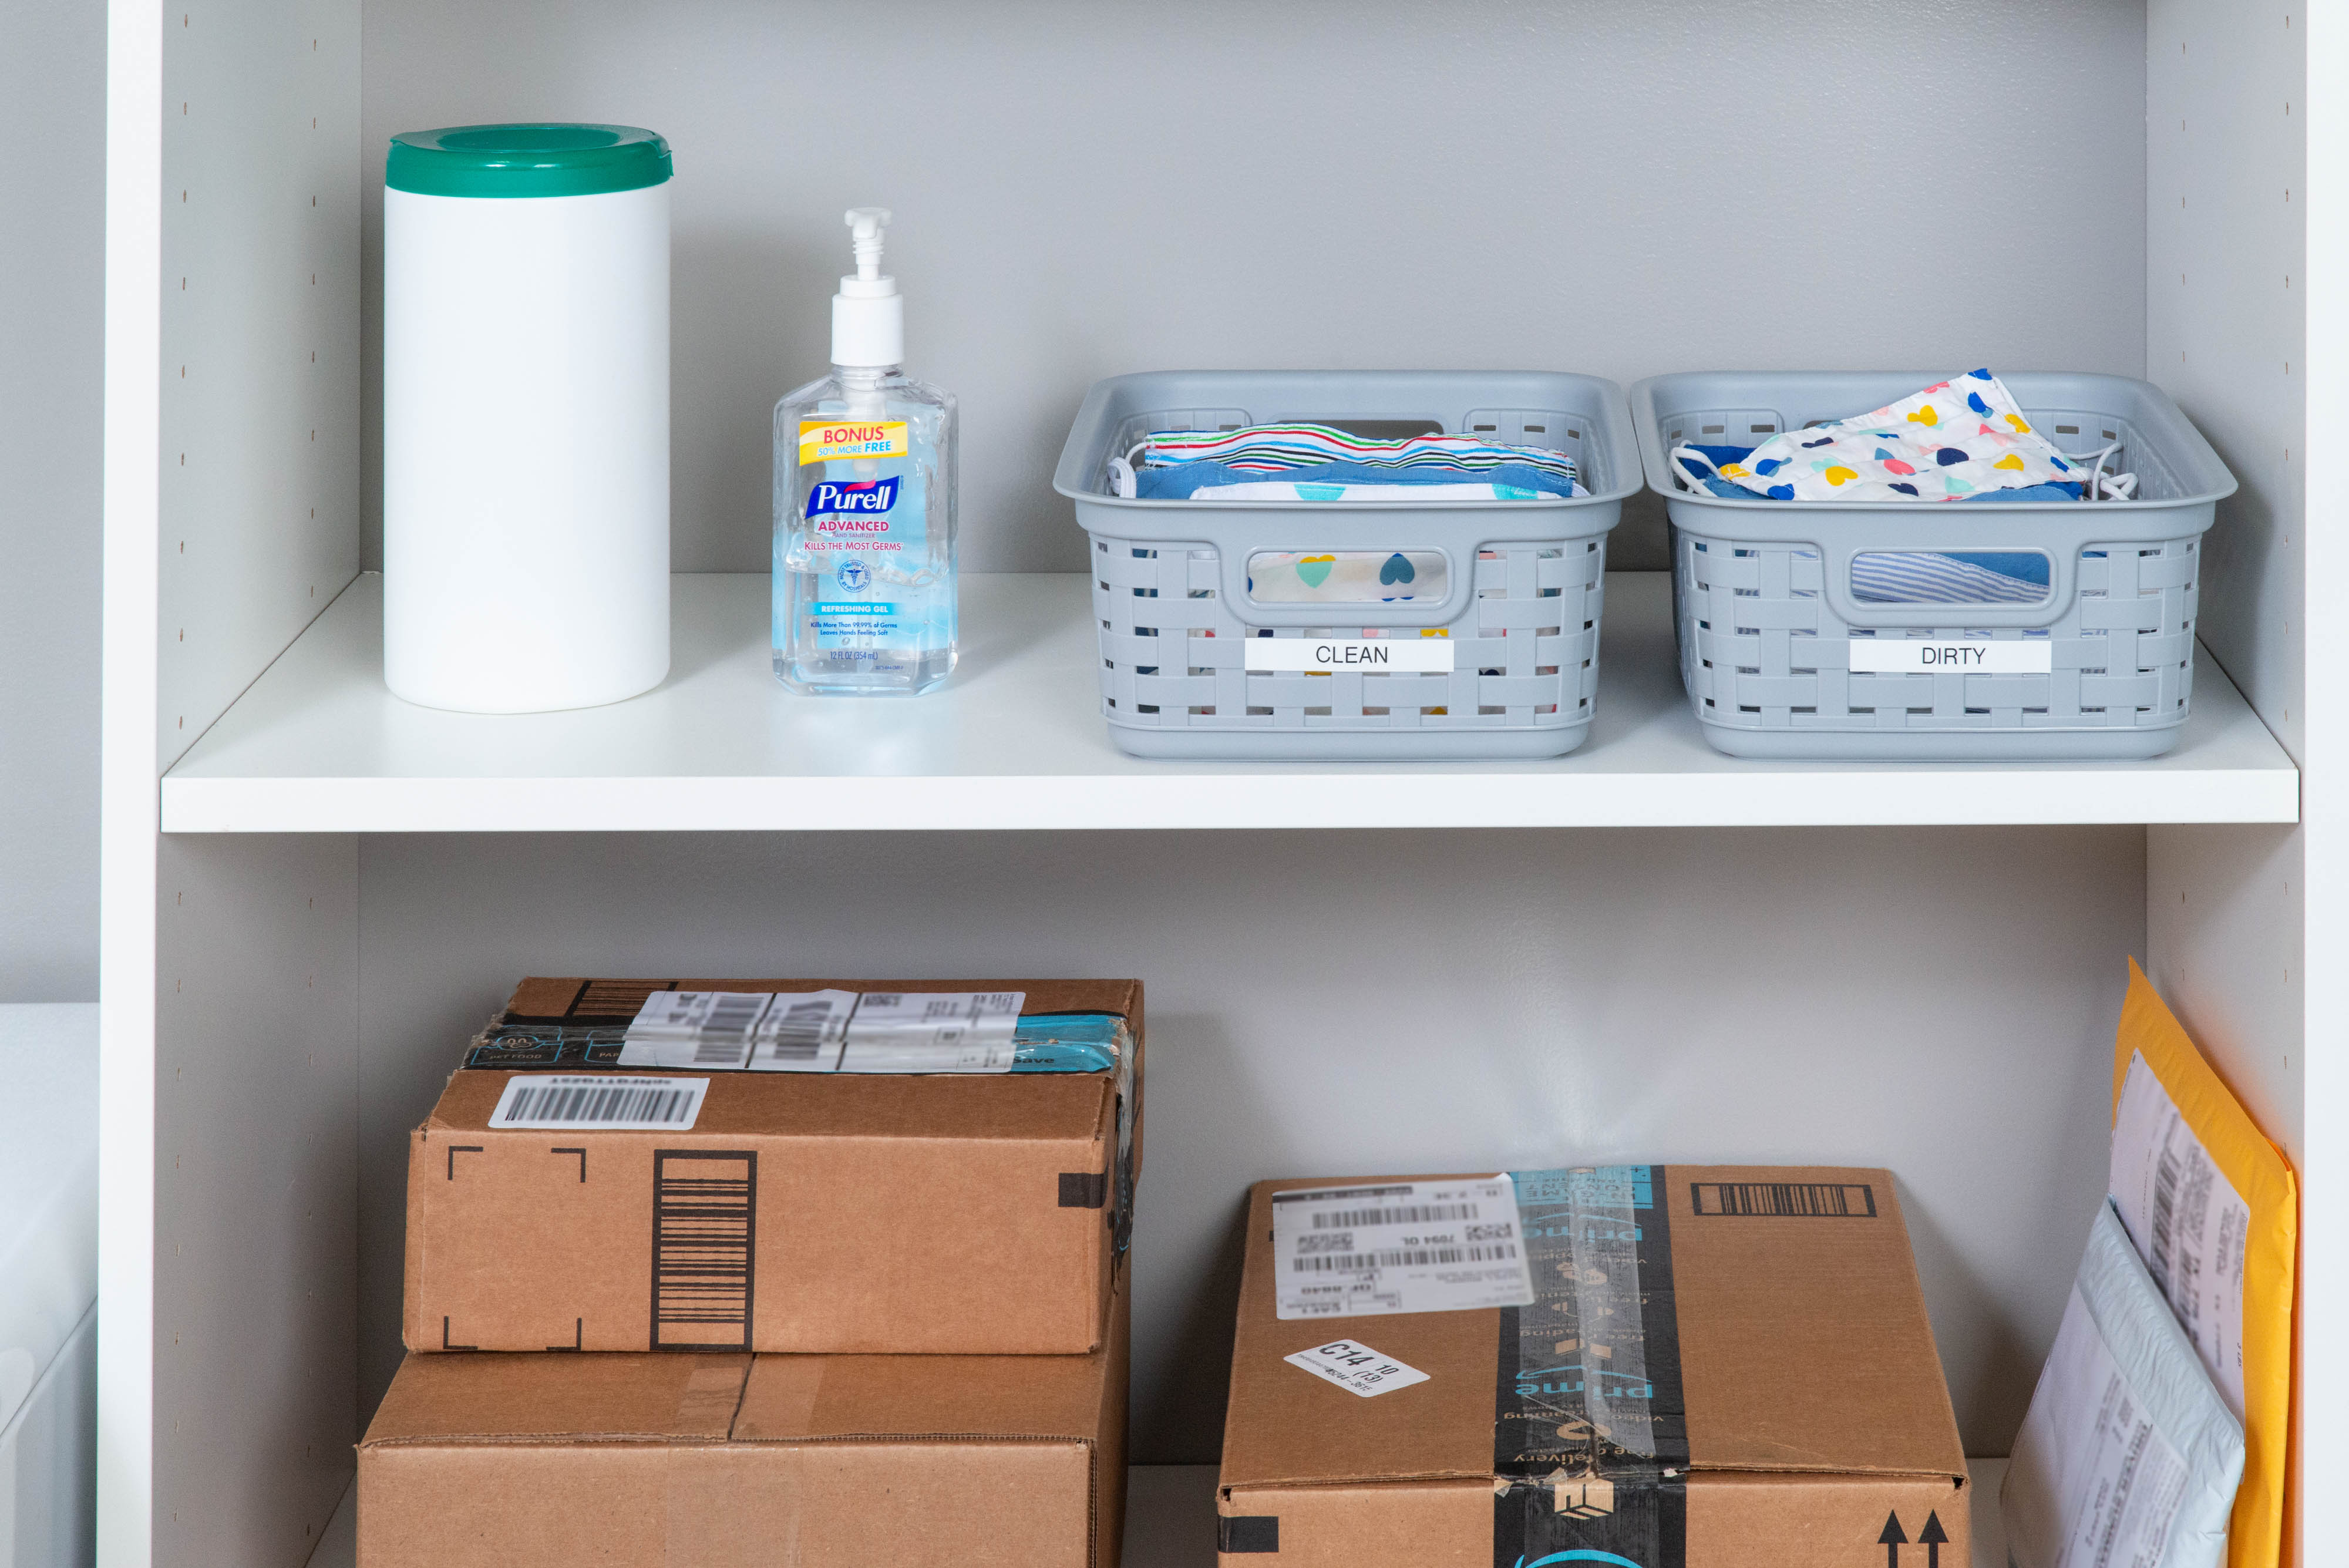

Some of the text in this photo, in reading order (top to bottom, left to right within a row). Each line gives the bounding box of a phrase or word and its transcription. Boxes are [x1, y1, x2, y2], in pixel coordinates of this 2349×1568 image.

[823, 426, 884, 444] BONUS
[817, 441, 891, 456] 50% MORE FREE
[817, 484, 891, 510] Purell
[817, 521, 889, 531] ADVANCED
[804, 541, 826, 550] KILLS
[828, 542, 843, 550] THE
[845, 541, 869, 551] MOST
[830, 651, 878, 661] 12 FL OZ (354 mL)
[1315, 646, 1388, 664] CLEAN
[1921, 647, 1986, 665] DIRTY
[1319, 1343, 1375, 1367] C14
[1375, 1363, 1399, 1375] 10
[1352, 1370, 1384, 1384] (13)
[1515, 1381, 1654, 1401] prime
[1613, 1414, 1664, 1422] video
